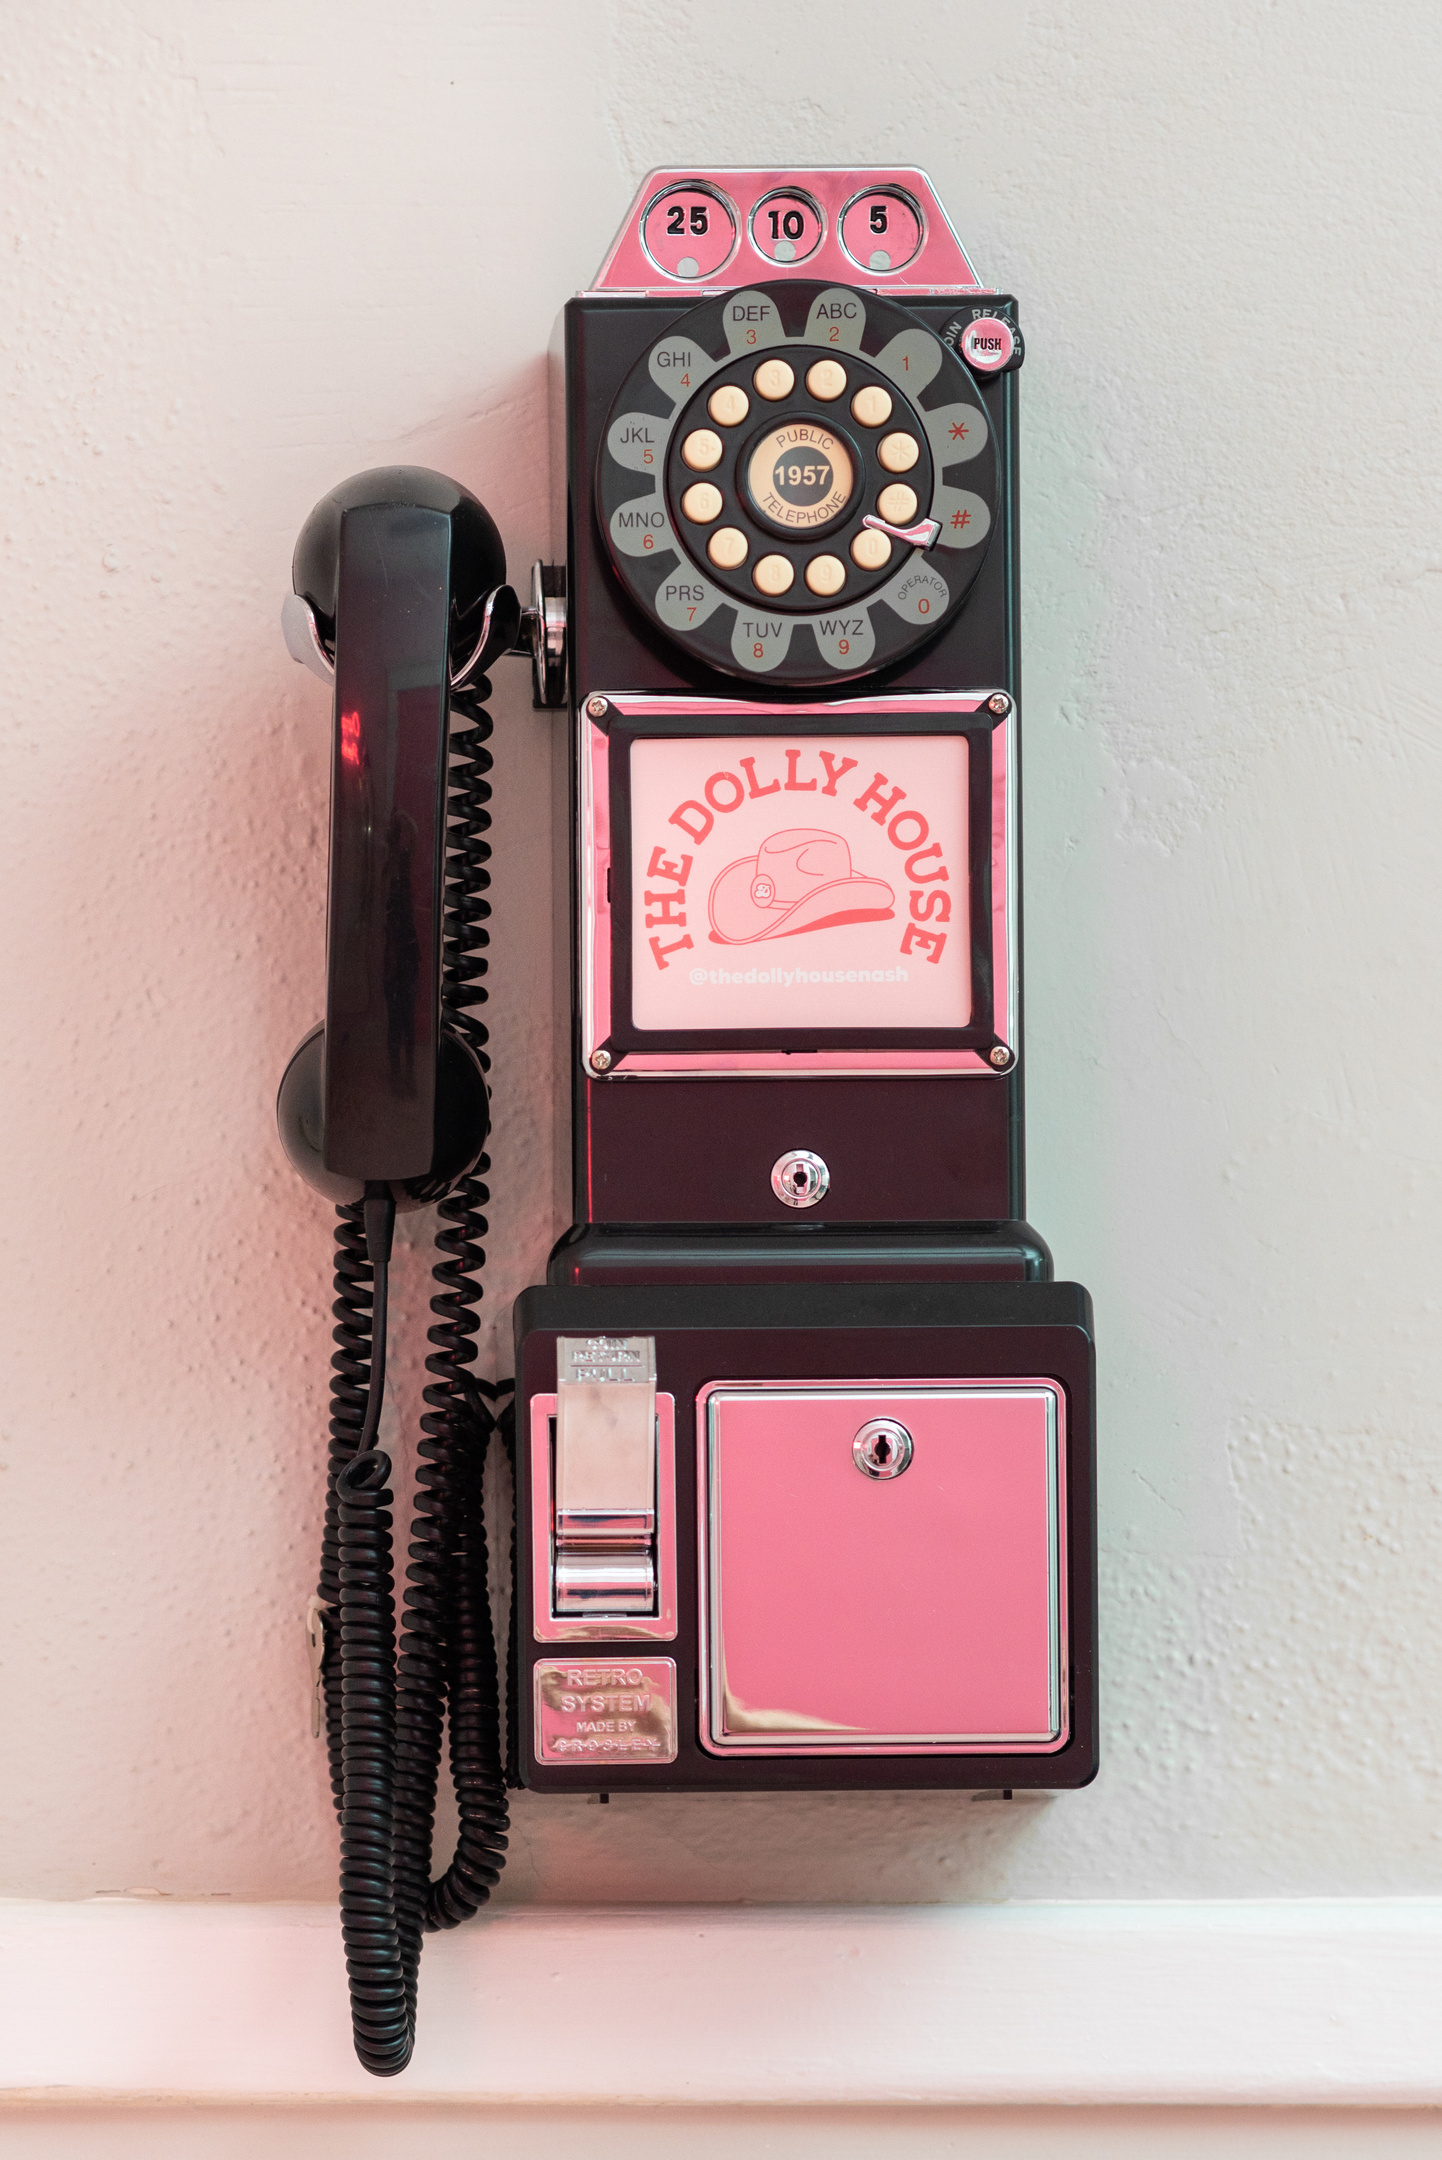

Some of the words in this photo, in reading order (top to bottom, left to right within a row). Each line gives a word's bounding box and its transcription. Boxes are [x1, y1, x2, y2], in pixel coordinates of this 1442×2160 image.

[667, 205, 709, 236] 25
[767, 210, 805, 241] 10
[869, 205, 889, 235] 5
[732, 305, 771, 322] DEF
[816, 302, 857, 319] ABC
[745, 329, 757, 345] 3
[828, 326, 840, 342] 2
[943, 321, 962, 347] OIN
[973, 337, 1002, 351] PUSH
[656, 351, 691, 368] GHI
[902, 355, 909, 371] 1
[680, 372, 691, 388] 4
[619, 427, 655, 444] JKL
[776, 428, 834, 450] PUBLIC
[642, 449, 654, 465] 5
[774, 465, 830, 486] 1957
[762, 491, 847, 524] TELEPHONE
[618, 511, 665, 528] MNO
[950, 509, 972, 529] #
[643, 534, 654, 550] 6
[666, 585, 705, 601] PRS
[897, 575, 948, 600] OPERATOR
[686, 607, 697, 622] 7
[918, 598, 930, 614] 0
[742, 622, 783, 638] TUV
[819, 620, 864, 636] WYZ
[752, 642, 764, 659] 8
[838, 639, 850, 655] 9
[667, 749, 859, 845] DOLLY
[852, 772, 952, 965] HOUSE
[644, 846, 694, 971] THE
[689, 966, 909, 987] @thedollyhousenash
[567, 1668, 643, 1686] RETRO
[561, 1694, 652, 1713] SYSTEM
[576, 1721, 615, 1733] MADE
[617, 1721, 637, 1733] BY
